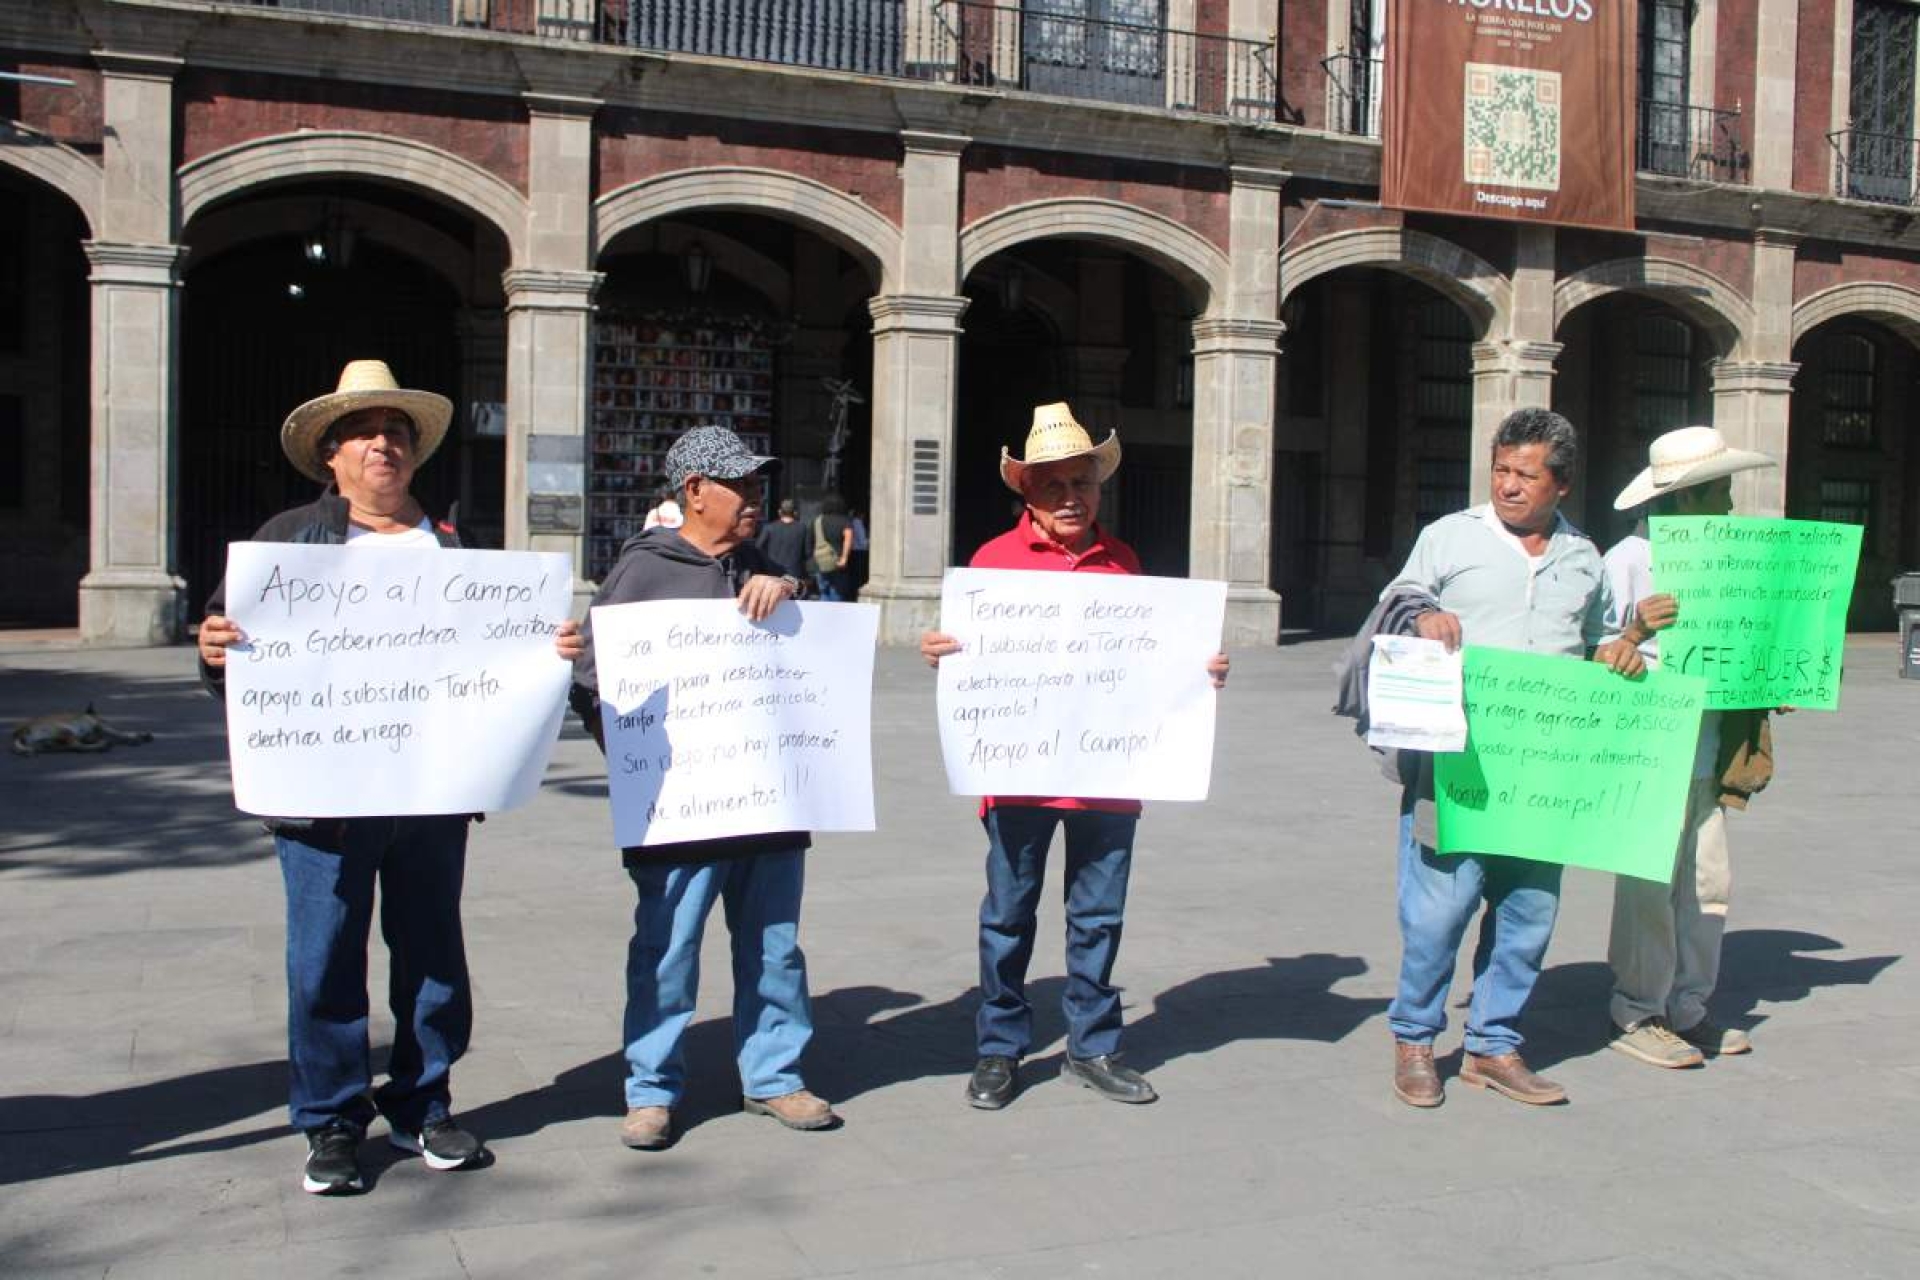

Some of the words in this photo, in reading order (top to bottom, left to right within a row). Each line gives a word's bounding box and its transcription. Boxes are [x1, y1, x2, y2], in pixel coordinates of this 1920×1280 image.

[1477, 191, 1524, 208] Descarga
[260, 564, 369, 616] Apoyo
[387, 575, 421, 602] al
[965, 588, 1060, 621] Tenemos
[1083, 598, 1153, 621] derecho
[248, 638, 292, 662] Sra
[306, 624, 459, 654] Gobernadora
[667, 623, 782, 650] Gobernadora
[989, 635, 1057, 655] subsidio
[242, 686, 302, 716] apoyo
[312, 684, 332, 709] al
[343, 680, 430, 708] subsidio
[434, 669, 502, 702] Tarifa
[674, 673, 710, 698] para
[722, 663, 813, 685] restablecer
[1087, 666, 1128, 694] riego
[1590, 690, 1622, 705] con
[1486, 703, 1526, 730] riego
[1535, 711, 1601, 737] agricola
[622, 752, 649, 775] Sin
[968, 737, 1029, 772] Apoyo
[1038, 728, 1060, 756] al
[1499, 783, 1517, 806] al
[646, 799, 670, 825] de
